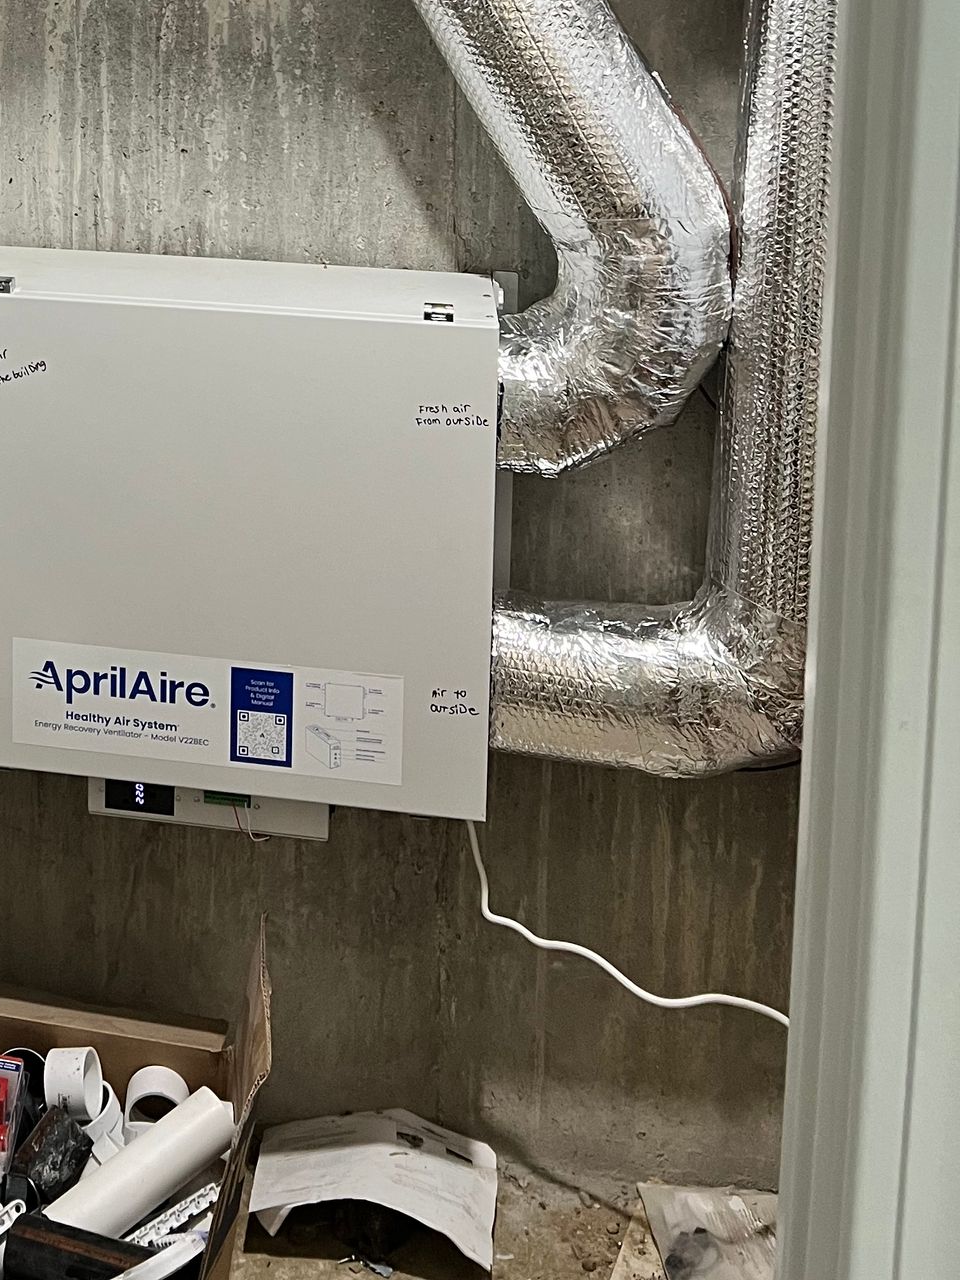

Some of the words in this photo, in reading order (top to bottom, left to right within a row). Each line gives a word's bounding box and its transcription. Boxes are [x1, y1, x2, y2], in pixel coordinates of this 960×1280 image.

[419, 404, 448, 414] Fresh
[452, 403, 471, 413] air
[27, 660, 211, 707] AprilAire
[245, 685, 267, 693] Product
[431, 688, 447, 698] Air
[453, 690, 467, 700] to
[65, 710, 113, 727] Healthy
[113, 716, 132, 726] Air
[132, 718, 178, 732] System
[34, 719, 63, 732] Energy
[63, 723, 103, 735] Recovery
[102, 727, 142, 738] Ventilator
[150, 733, 177, 743] Model
